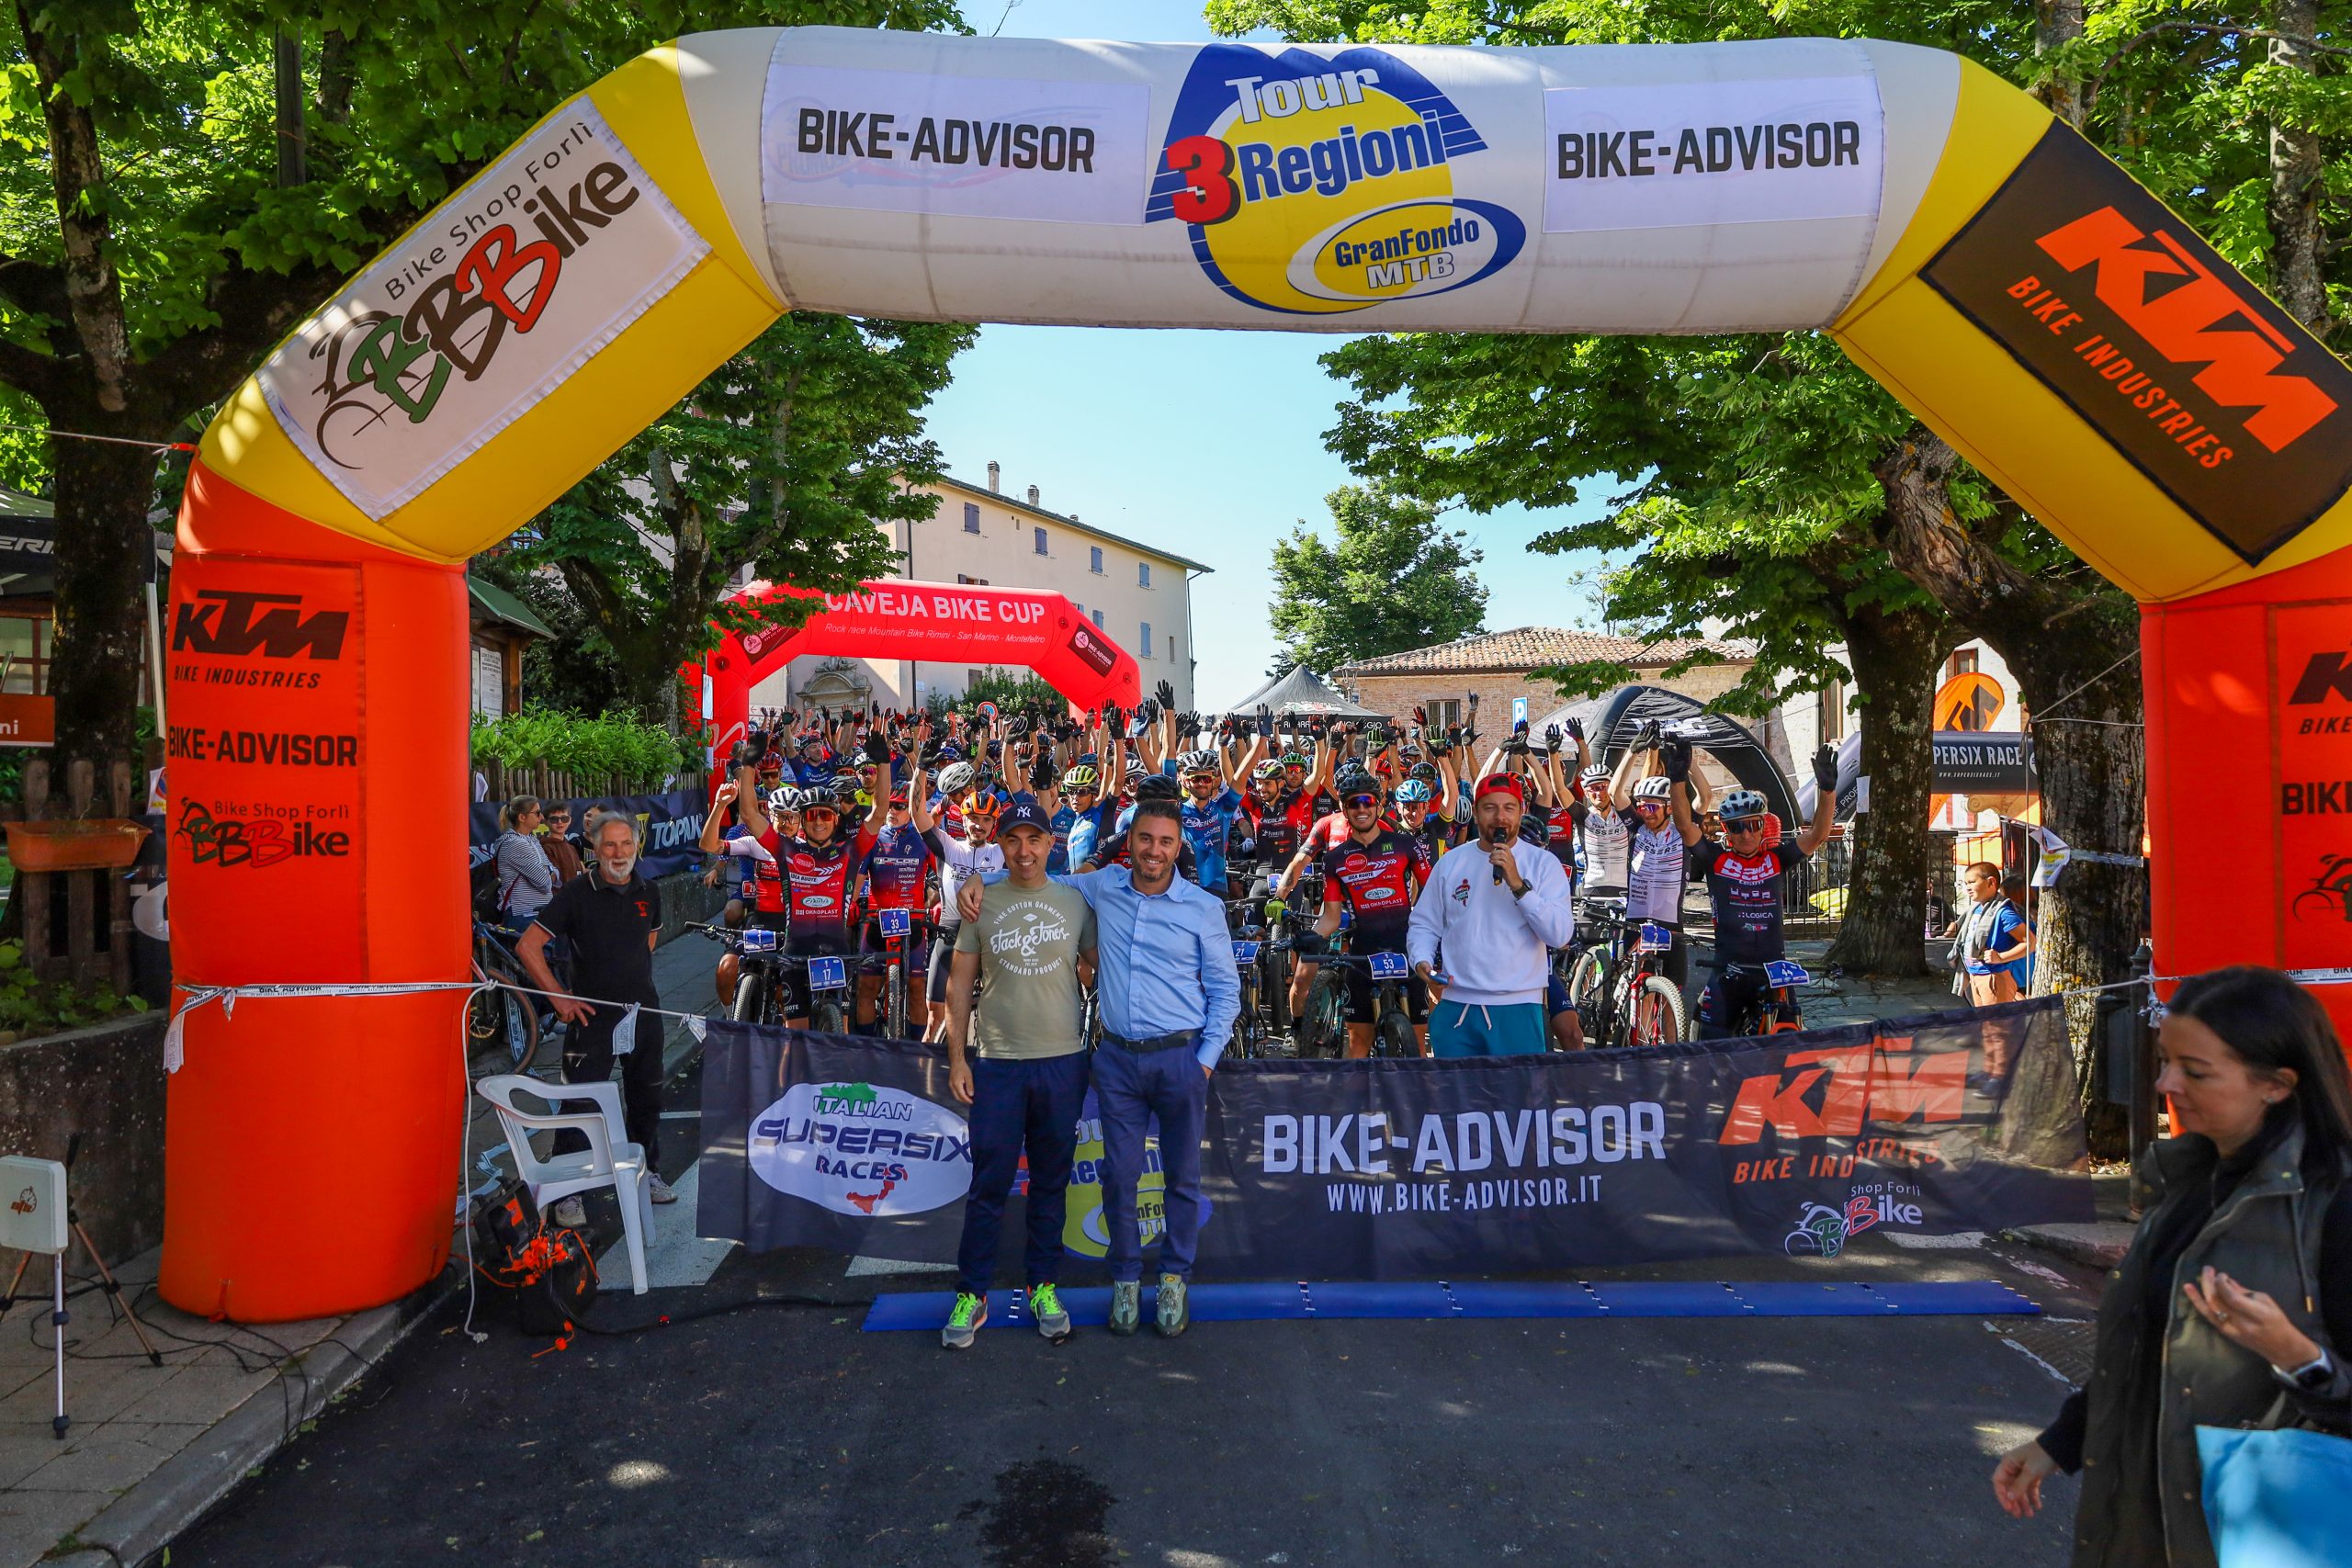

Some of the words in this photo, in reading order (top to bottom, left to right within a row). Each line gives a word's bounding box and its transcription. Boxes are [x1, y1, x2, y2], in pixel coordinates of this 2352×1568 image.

[1225, 65, 1381, 125] Tour
[797, 107, 1096, 175] BIKE-ADVISOR
[1556, 120, 1861, 181] BIKE-ADVISOR
[1166, 133, 1241, 225] 3
[1238, 107, 1450, 204] Regioni
[384, 243, 448, 303] Bike
[448, 180, 524, 248] Shop
[526, 120, 595, 186] Forlì
[1334, 217, 1481, 269] GranFondo
[1365, 251, 1456, 290] MTB
[2034, 205, 2339, 454] KTM
[2007, 274, 2083, 337] BIKE
[2072, 332, 2236, 470] INDUSTRIES
[824, 591, 929, 618] CAVEJA
[933, 596, 992, 623] BIKE
[998, 601, 1046, 624] CUP
[171, 589, 350, 661] KTM
[824, 623, 846, 634] Rock
[848, 626, 866, 635] race
[867, 626, 906, 637] Mountain
[907, 628, 925, 638] Bike
[926, 629, 951, 639] Rimini
[956, 631, 973, 640] San
[974, 632, 1000, 642] Marino
[1005, 634, 1046, 644] Montefeltro
[174, 664, 198, 683] BIKE
[205, 667, 322, 691] INDUSTRIES
[1515, 701, 1526, 719] P
[0, 719, 18, 735] ni
[168, 725, 358, 768] BIKE-ADVISOR
[1932, 746, 1983, 765] PERSIX
[214, 800, 249, 818] Bike
[253, 801, 300, 821] Shop
[305, 801, 350, 819] Forlì
[1589, 825, 1625, 836] ESSERE
[1638, 842, 1679, 855] ESSERE
[890, 919, 899, 930] 33
[993, 910, 1008, 925] FINE
[1007, 900, 1033, 914] COTTON
[1035, 901, 1067, 924] GARMENTS
[990, 926, 1022, 954] Jack
[1021, 935, 1036, 956] &
[1029, 920, 1070, 945] Jones
[1235, 947, 1245, 957] 21
[1653, 932, 1658, 943] 2
[822, 968, 831, 981] 17
[999, 958, 1032, 976] STANDARD
[1035, 956, 1063, 976] PRODUCT
[1383, 959, 1395, 969] 53
[1781, 968, 1793, 977] 44
[1718, 1035, 1971, 1146] KTM
[812, 1093, 913, 1122] ITALIAN
[752, 1118, 974, 1166] SUPERSIX
[1263, 1100, 1667, 1175] BIKE-ADVISOR
[814, 1155, 907, 1184] RACES
[1733, 1156, 1795, 1184] BIKE
[1808, 1137, 1941, 1179] INDSTRIES
[1327, 1173, 1602, 1215] WWW.BIKE-ADVISOR.IT
[1850, 1182, 1883, 1197] Shop
